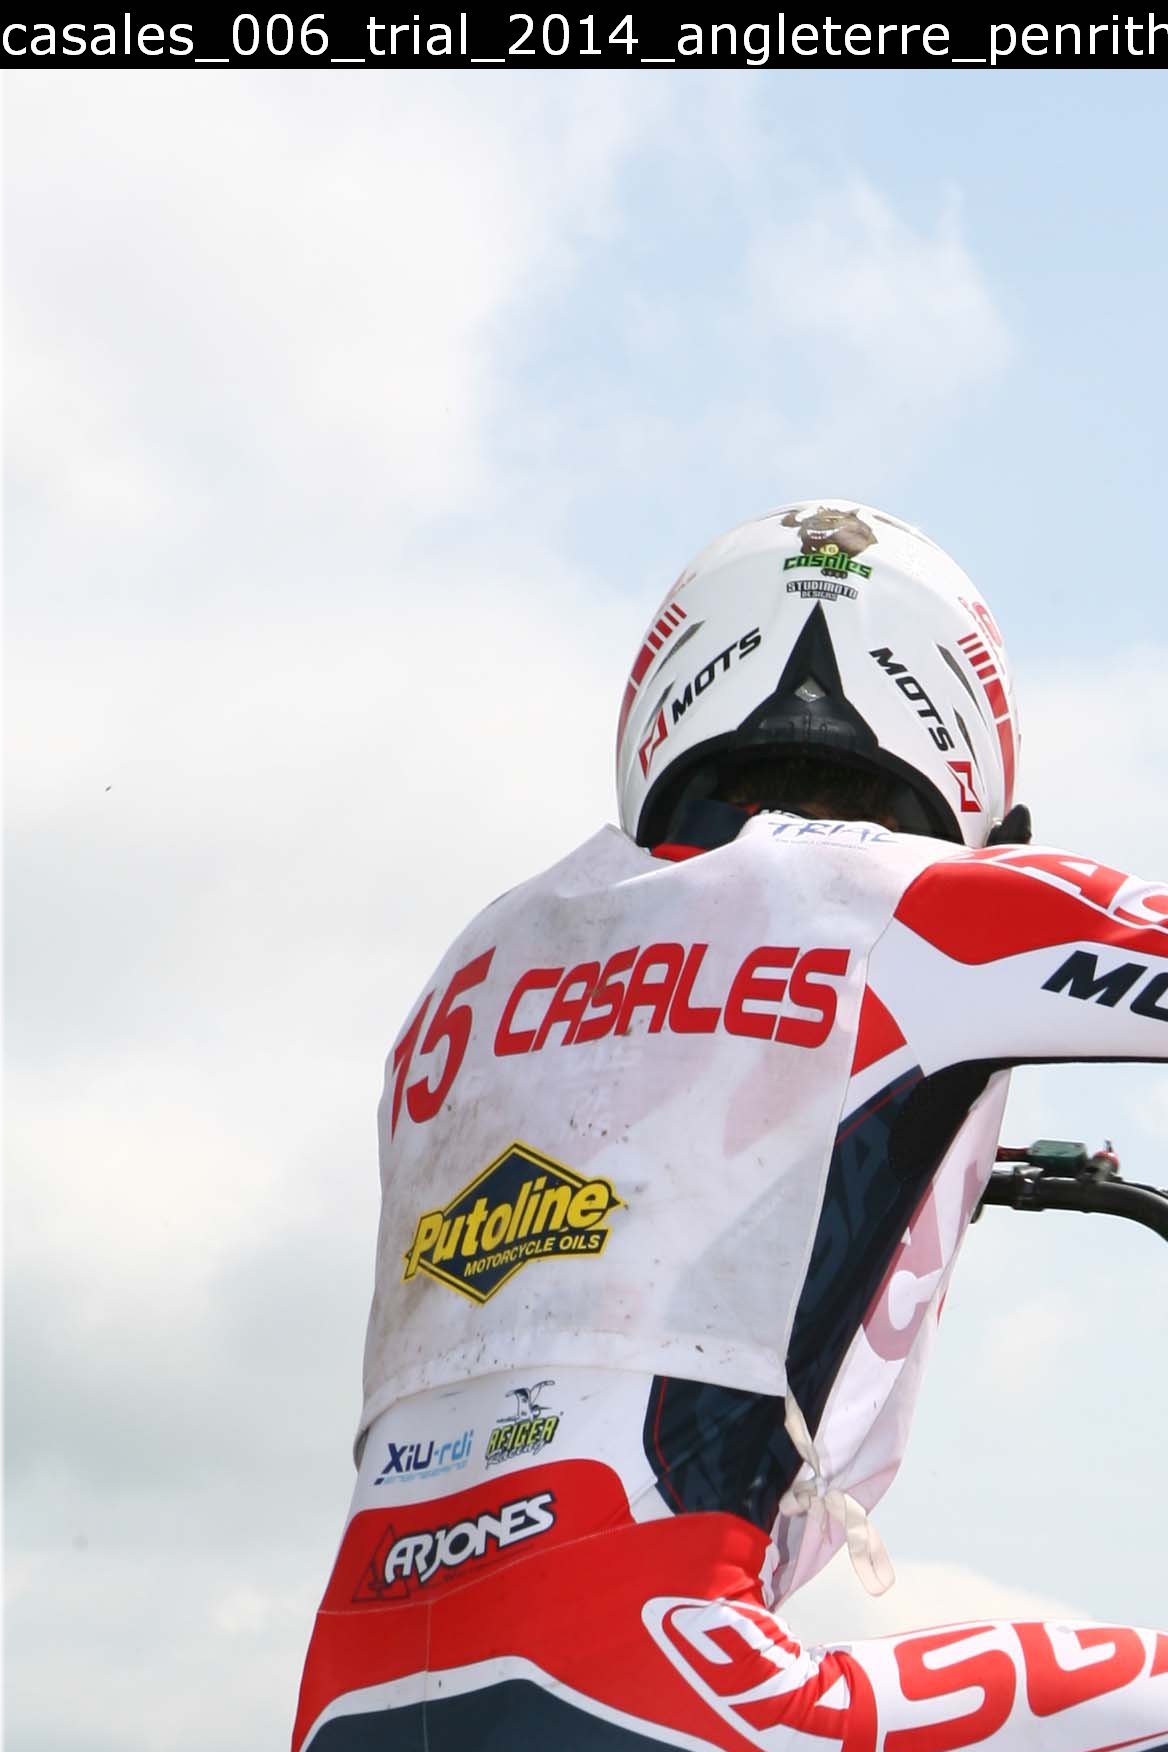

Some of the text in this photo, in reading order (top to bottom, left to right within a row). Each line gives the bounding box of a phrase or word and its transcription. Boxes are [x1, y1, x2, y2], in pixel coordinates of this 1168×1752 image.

[671, 628, 762, 725] MOTS
[869, 647, 955, 751] MOTS
[391, 943, 851, 1143] 15 CASALES
[404, 1176, 610, 1280] Putoline
[464, 1235, 601, 1277] MOTORCYCLE OILS
